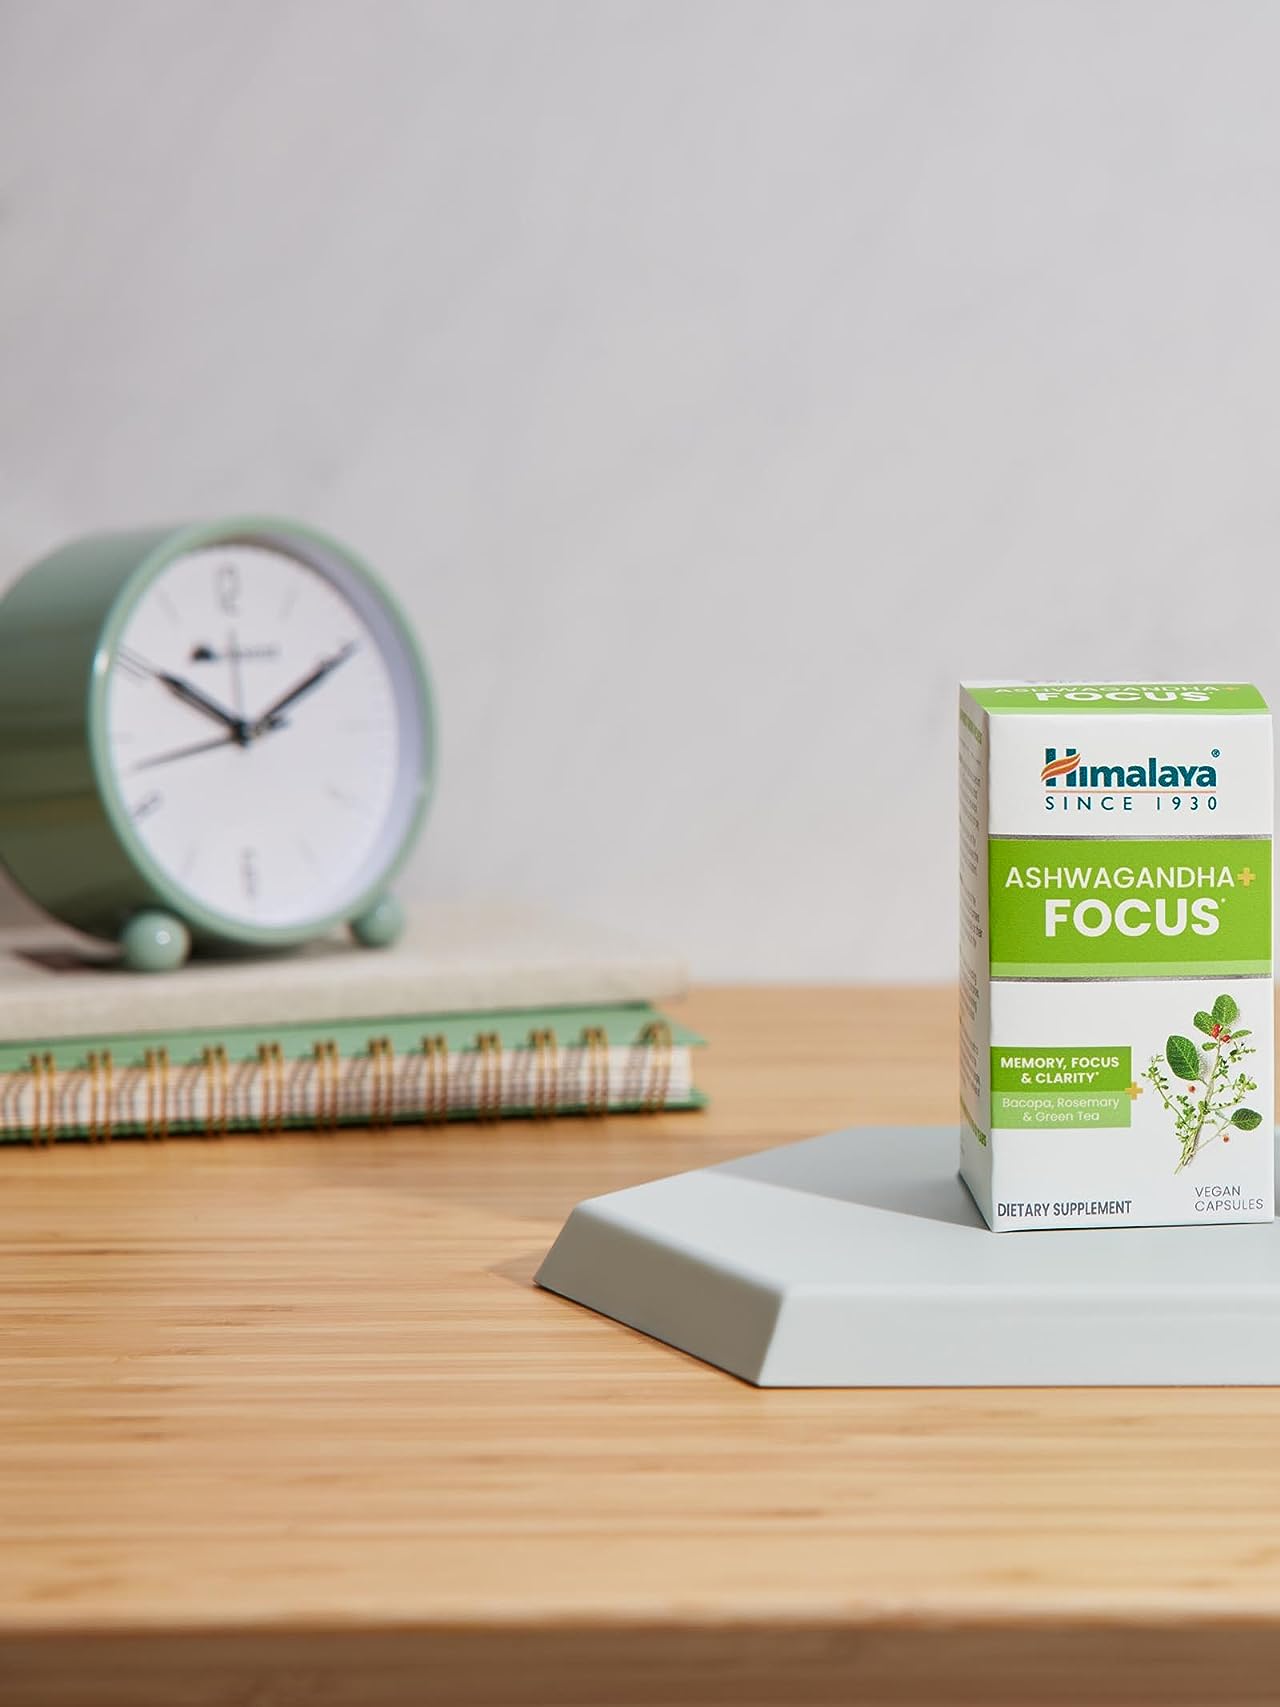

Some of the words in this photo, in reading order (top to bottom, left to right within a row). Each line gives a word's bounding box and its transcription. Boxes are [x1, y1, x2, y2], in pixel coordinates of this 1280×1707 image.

[1045, 796, 1132, 810] SINCE
[1157, 796, 1217, 810] 1930
[1000, 1057, 1067, 1071] MEMORY,
[1071, 1057, 1120, 1069] FOCUS
[1020, 1073, 1032, 1085] &
[1002, 1098, 1055, 1111] Bacopa,
[1057, 1097, 1120, 1109] Rosemary
[1023, 1111, 1032, 1122] &
[1035, 1111, 1074, 1122] Green
[1077, 1111, 1100, 1121] Tea
[1195, 1185, 1241, 1198] VEGAN
[997, 1202, 1050, 1218] DIETARY
[1053, 1200, 1132, 1217] SUPPLEMENT
[1194, 1197, 1264, 1212] CAPSULES
